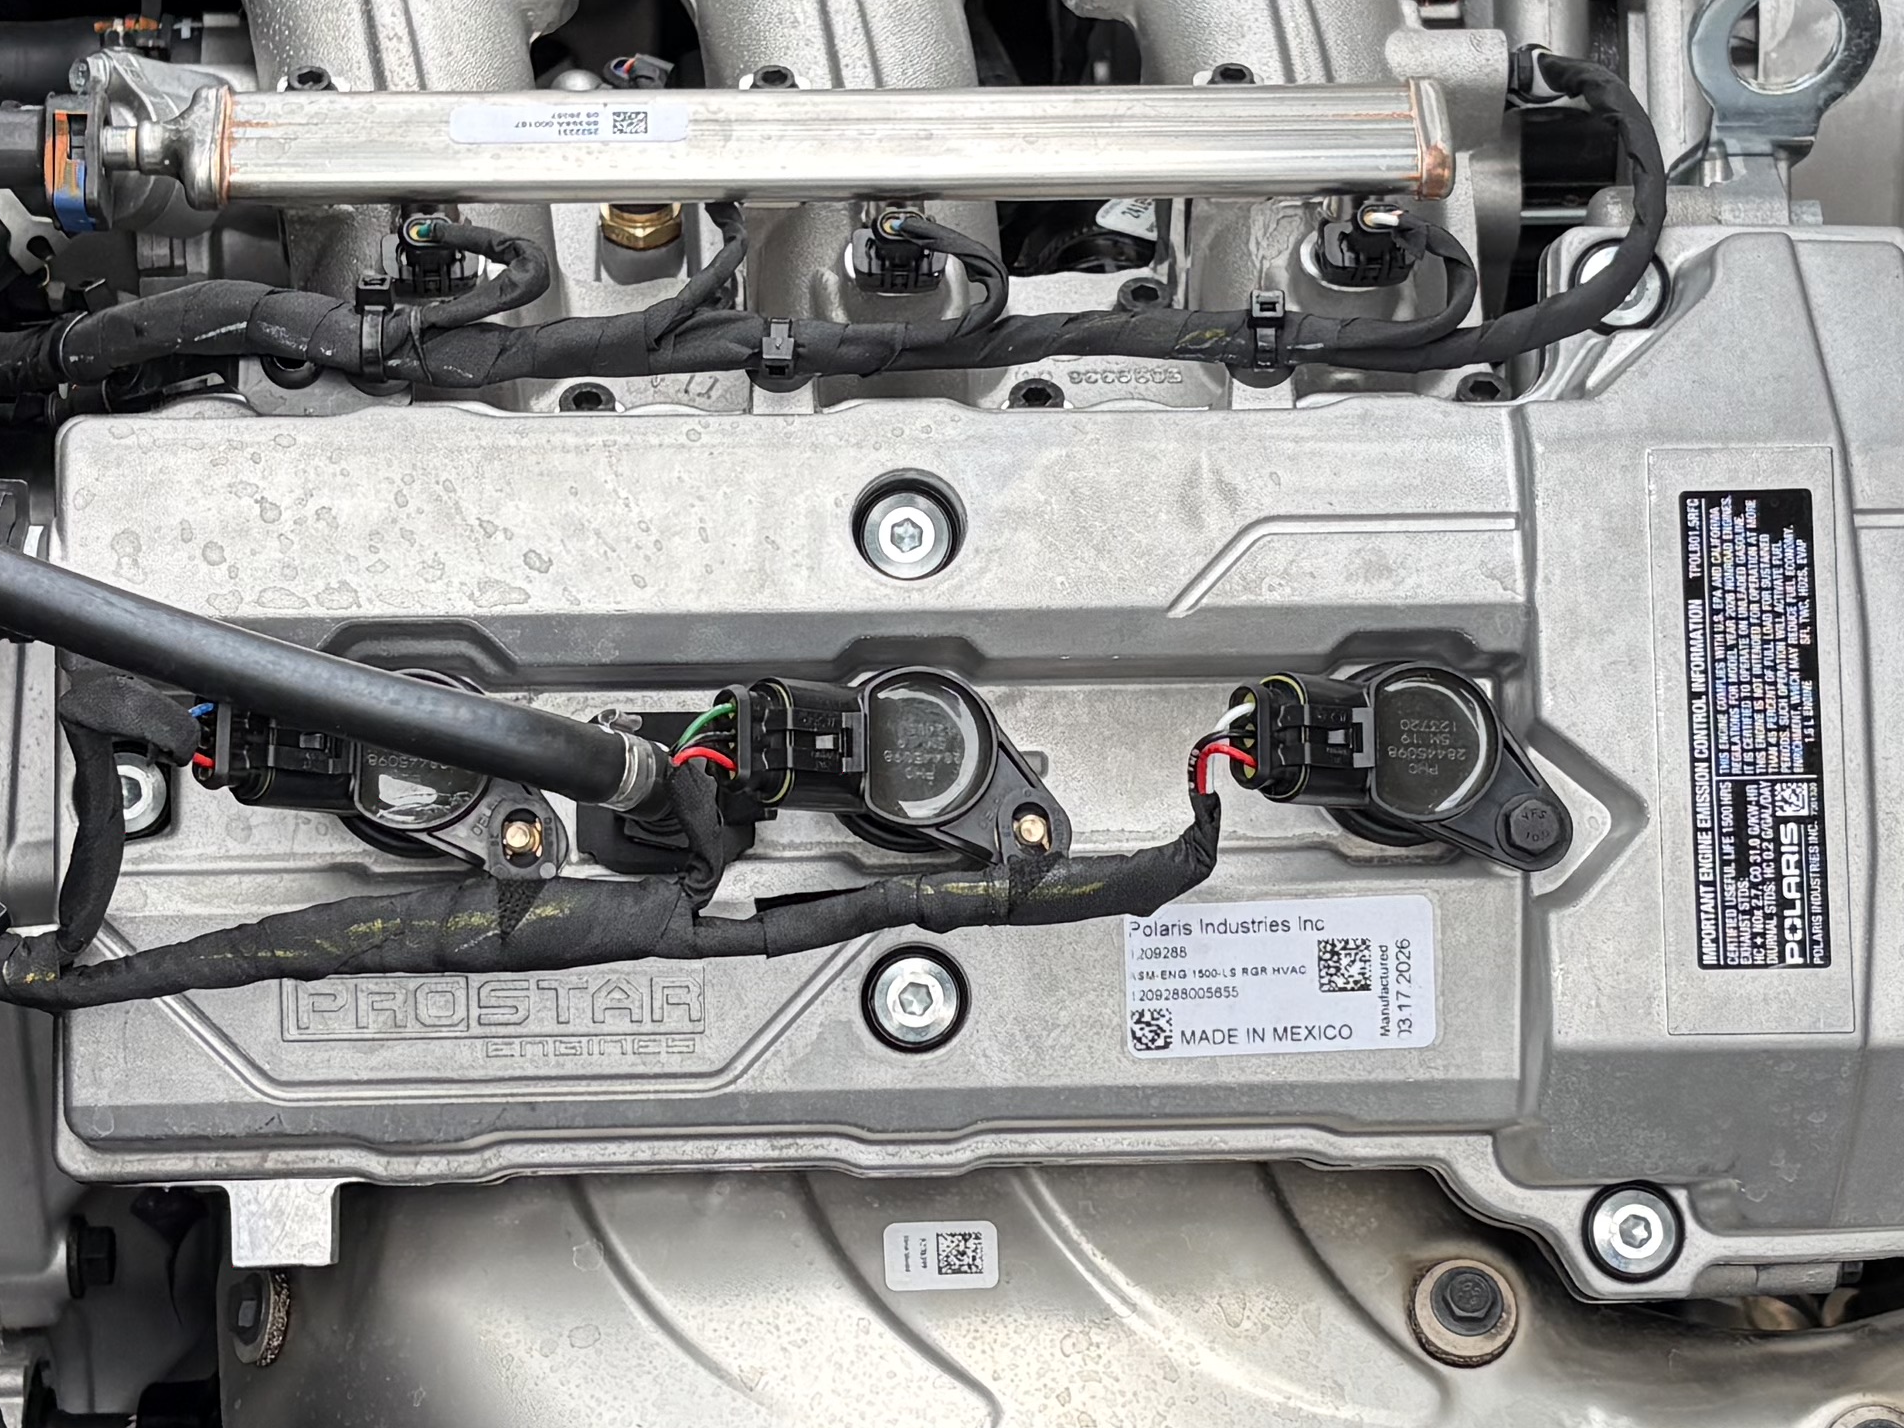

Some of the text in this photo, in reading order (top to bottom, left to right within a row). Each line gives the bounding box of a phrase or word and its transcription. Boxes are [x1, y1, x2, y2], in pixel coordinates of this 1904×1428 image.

[1709, 507, 1721, 563] CALIFORNIA
[1723, 543, 1734, 590] NONROAD
[1772, 540, 1782, 564] FUEL
[1796, 539, 1807, 564] EVAP
[1711, 567, 1722, 587] AND
[1736, 567, 1747, 617] UNLEADED
[1773, 568, 1784, 612] ACTIVATE
[1785, 578, 1796, 603] FUEL
[1713, 590, 1723, 609] EPA
[1726, 593, 1736, 617] 2026
[1726, 620, 1736, 645] YEAR
[1738, 621, 1748, 634] ON
[1745, 500, 1766, 773] THIS ENGINE IS NOT INTENDED FOR OPERATION AT MORE
[1775, 615, 1785, 639] WILL
[1787, 606, 1798, 644] REDUCE
[1688, 599, 1706, 692] INFORMATION
[1714, 634, 1724, 659] WITH
[1739, 638, 1750, 681] OPERATE
[1760, 534, 1778, 773] THAN 45 PERCENT OF FULL LOAD FOR SUSTAINED
[1789, 647, 1799, 668] MAY
[1727, 648, 1737, 682] MODEL
[1775, 642, 1788, 696] OPERATION
[1716, 662, 1726, 710] COMPLIES
[1728, 685, 1739, 704] FOR
[1741, 685, 1750, 697] TO
[1790, 672, 1801, 703] WHICH
[1802, 680, 1813, 716] ENGINE
[1399, 718, 1457, 732] 123720
[1692, 695, 1708, 758] CONTROL
[1741, 701, 1753, 749] CERTIFIED
[1779, 699, 1789, 725] SUCH
[1717, 714, 1728, 749] ENGINE
[1730, 708, 1742, 774] REGULATIONS
[366, 753, 449, 769] 8445098
[1387, 745, 1466, 761] 28445098
[1719, 752, 1729, 773] THIS
[1743, 752, 1753, 761] IS
[1744, 764, 1754, 773] IT
[1695, 763, 1712, 828] EMISSION
[1697, 831, 1714, 881] ENGINE
[1748, 839, 1761, 863] 31.0
[1720, 782, 1738, 964] CERTIFIED USEFUL LIFE 1500 HRS
[1750, 867, 1761, 881] CO
[1759, 781, 1778, 964] DIURNAL STDS: HC 0.2 G/GAL/DAY
[1780, 822, 1803, 963] POLARIS
[1808, 821, 1824, 964] POLARIS INDUSTRIES INC.
[1129, 915, 1324, 937] Polaris Industries Inc
[1699, 885, 1717, 964] IMPORTANT
[1737, 877, 1751, 964] EXHAUST STDS:
[1241, 966, 1267, 977] RGR
[1273, 965, 1306, 975] HVAC
[1753, 949, 1765, 964] HC
[296, 977, 703, 1030] PROSTAR
[1377, 945, 1391, 1037] Manufactured
[485, 1038, 697, 1058] ENGINES
[1181, 1024, 1352, 1046] MADE IN MEXICO
